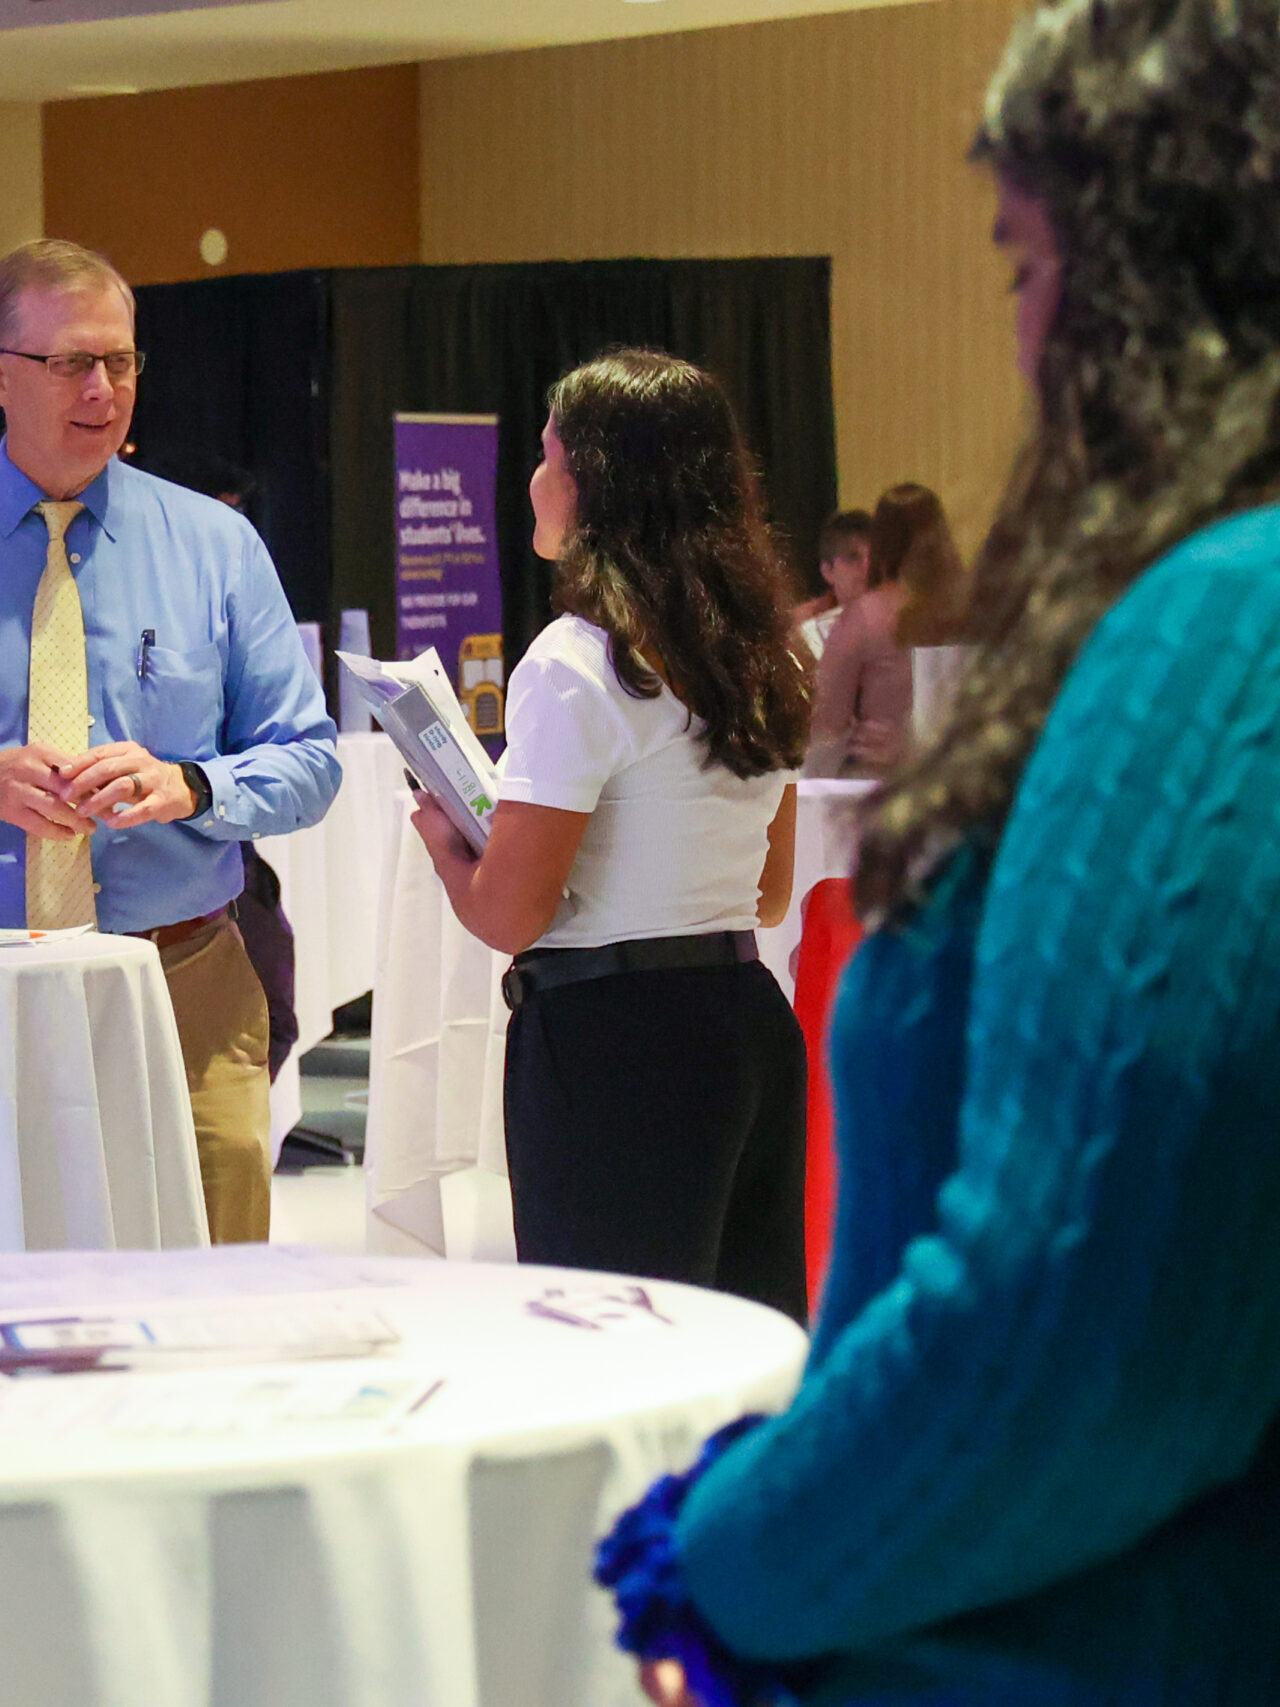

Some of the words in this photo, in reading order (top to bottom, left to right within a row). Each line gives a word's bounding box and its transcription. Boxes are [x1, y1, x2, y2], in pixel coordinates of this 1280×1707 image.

[399, 469, 431, 492] Make
[432, 473, 440, 491] a
[441, 468, 462, 497] big
[399, 496, 458, 519] difference
